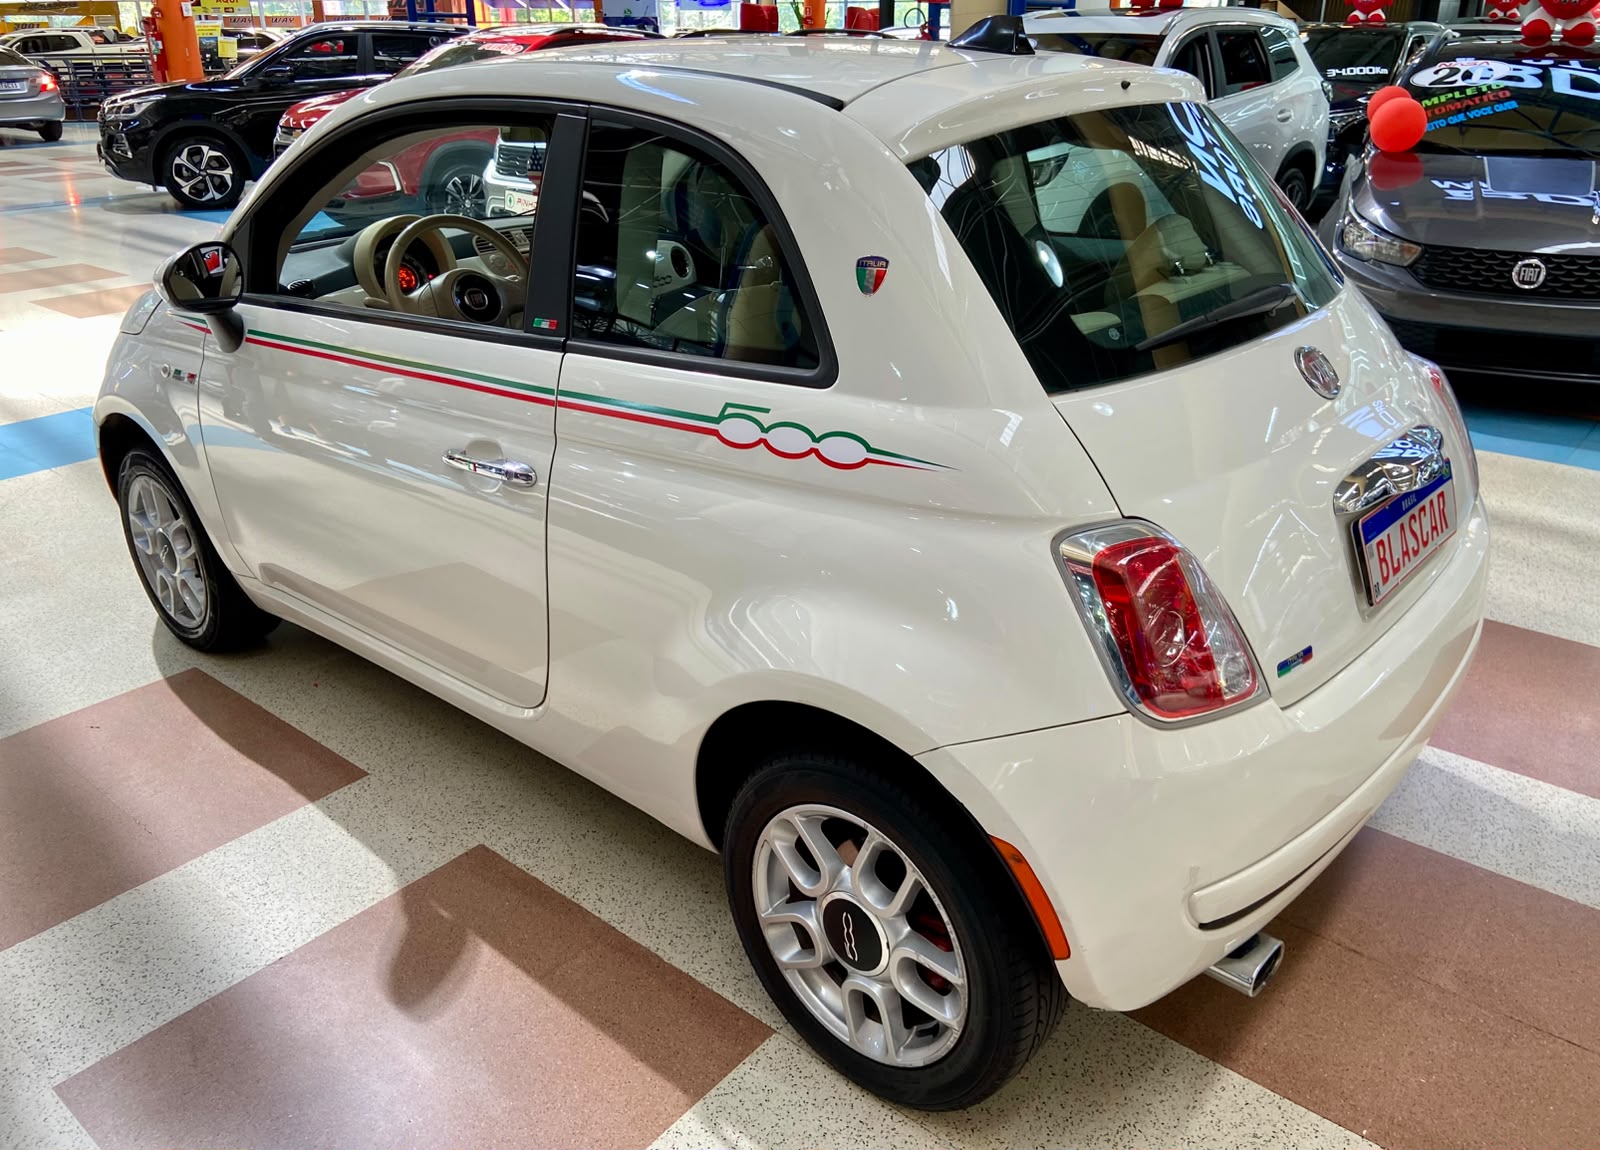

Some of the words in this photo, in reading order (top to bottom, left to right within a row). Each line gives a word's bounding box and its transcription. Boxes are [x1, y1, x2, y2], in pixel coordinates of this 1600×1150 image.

[1422, 81, 1505, 107] MPLETO
[1426, 90, 1512, 117] TOMATICO
[859, 260, 887, 268] ITALIA
[1520, 267, 1541, 282] FIAT
[717, 402, 872, 470] 500
[1375, 490, 1449, 586] BLASCAR
